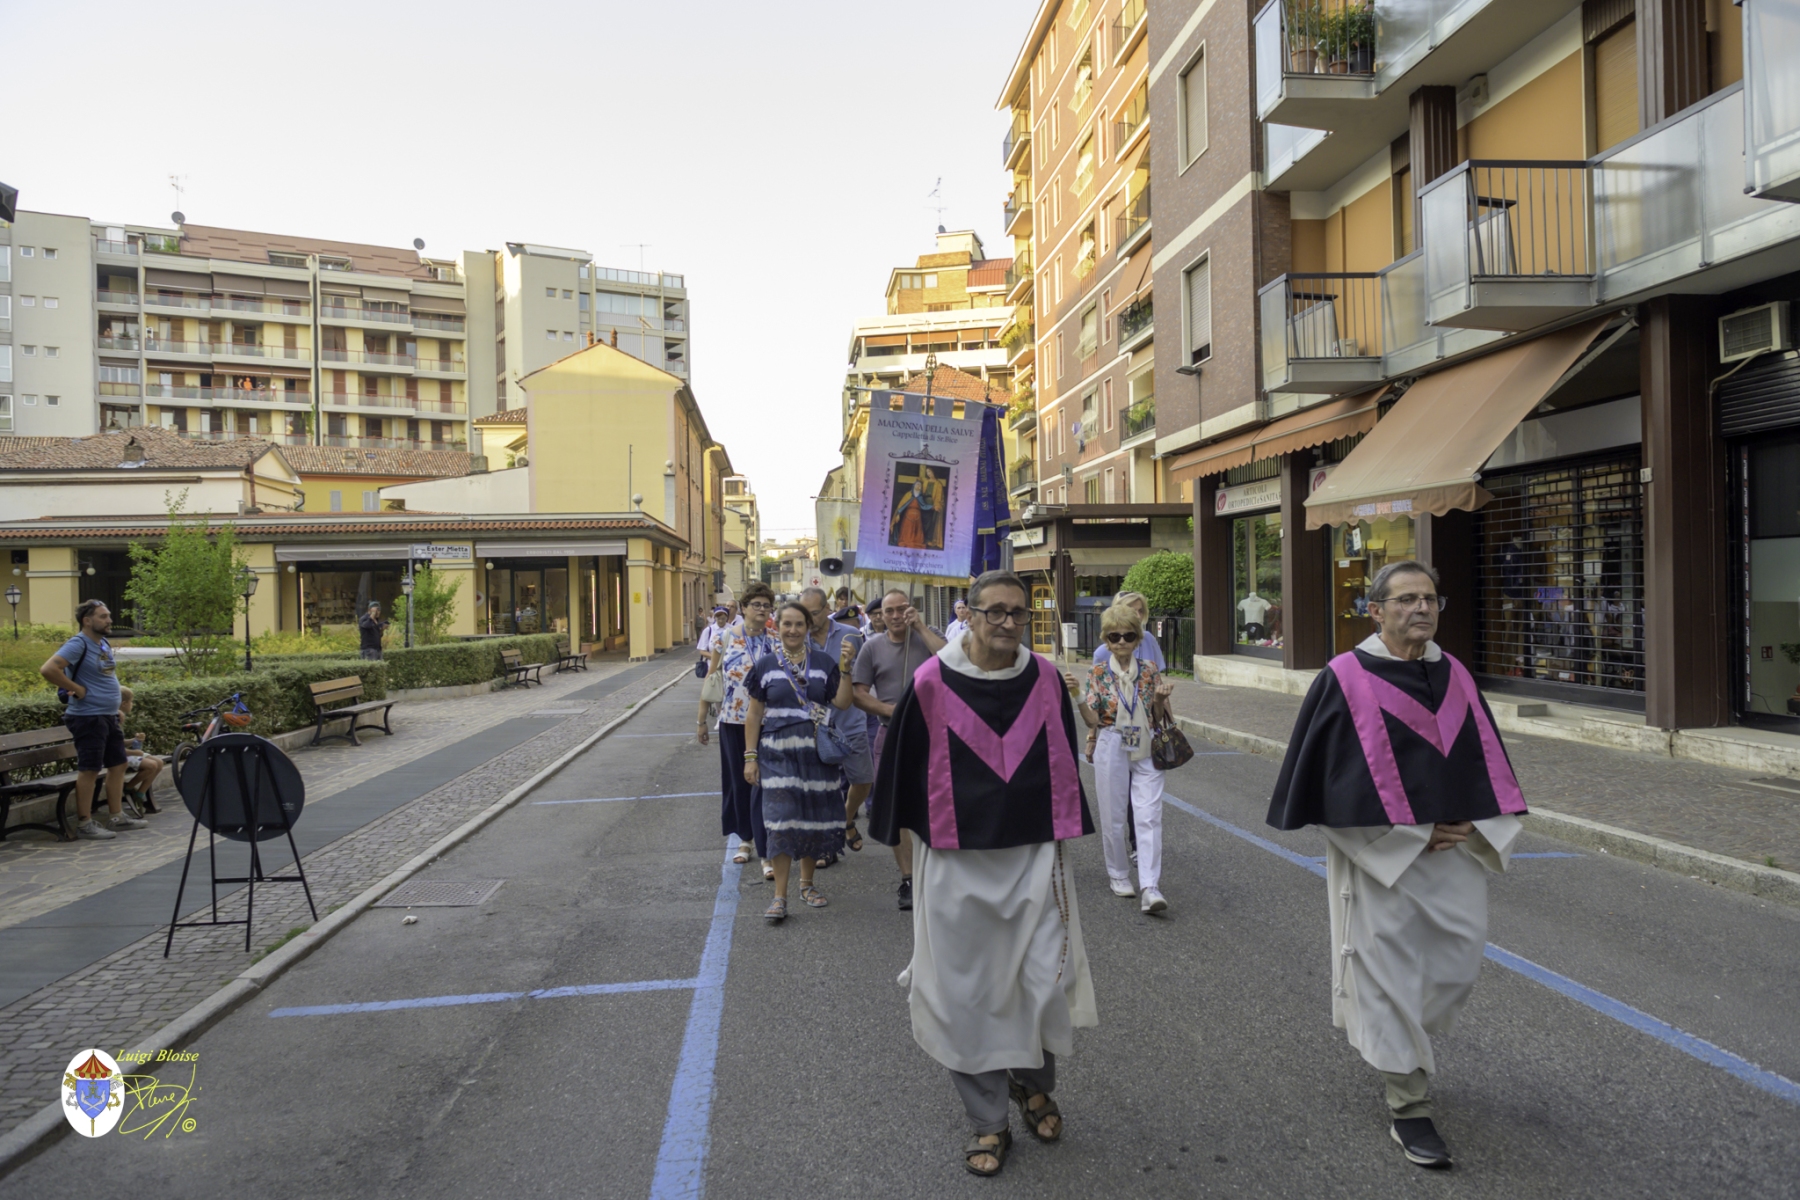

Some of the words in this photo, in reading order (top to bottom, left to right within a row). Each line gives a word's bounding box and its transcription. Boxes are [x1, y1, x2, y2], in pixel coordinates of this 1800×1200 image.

[877, 418, 924, 432] MADONNA
[925, 424, 949, 435] DELLA
[950, 427, 975, 438] SALVE
[1243, 483, 1267, 496] ARTICOLI
[1228, 496, 1257, 509] ORTOPEDICI
